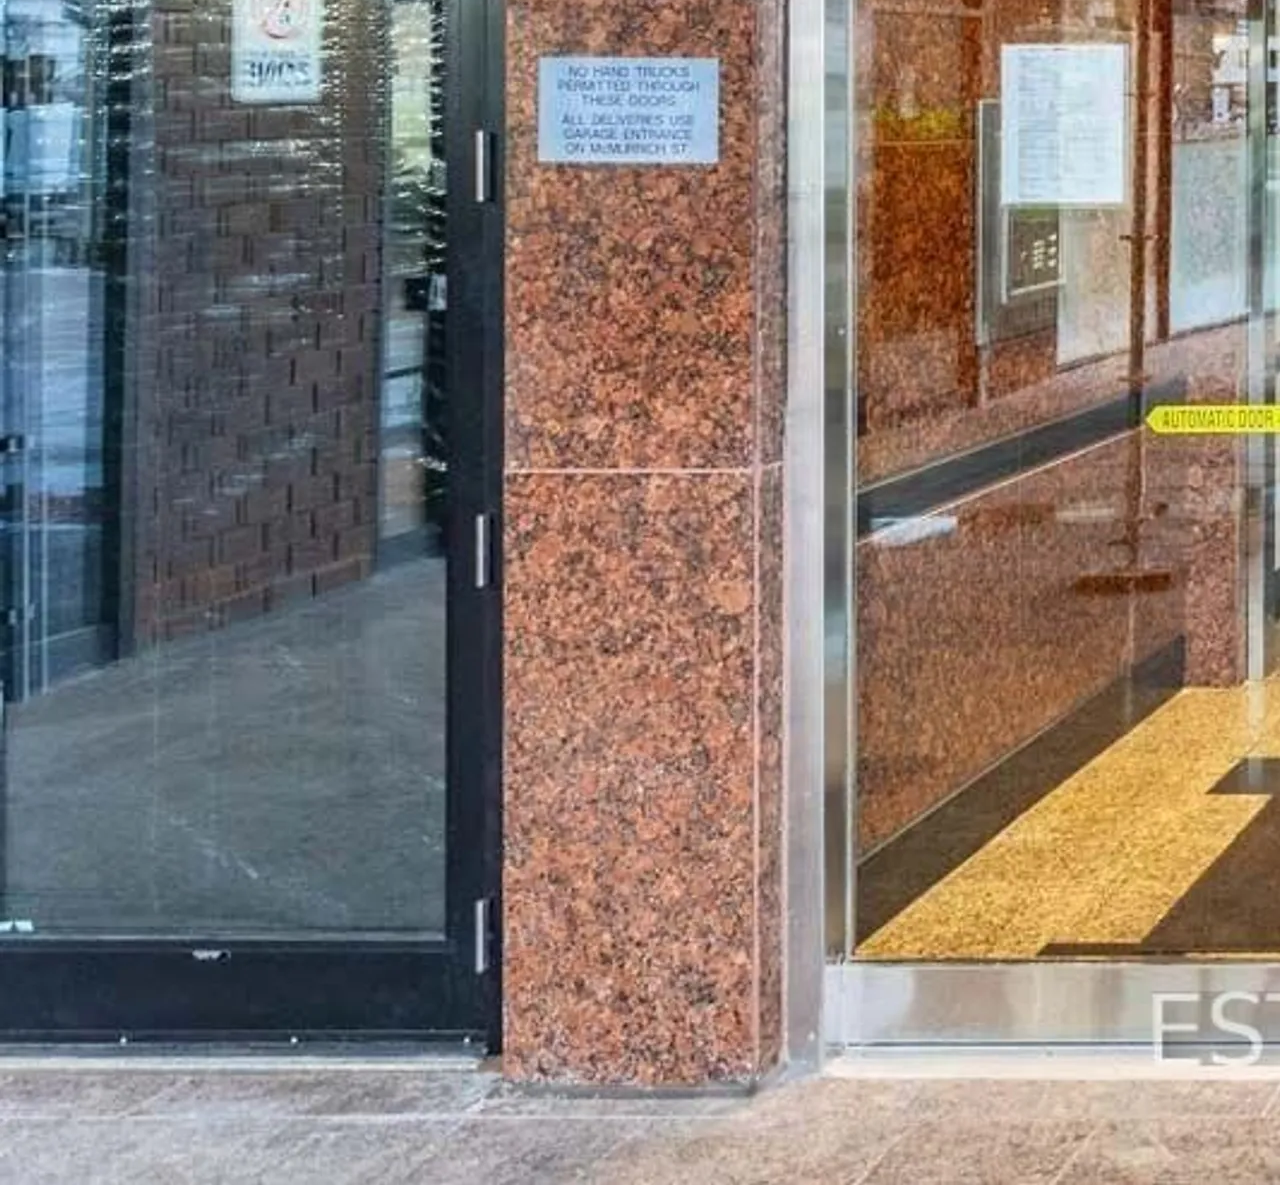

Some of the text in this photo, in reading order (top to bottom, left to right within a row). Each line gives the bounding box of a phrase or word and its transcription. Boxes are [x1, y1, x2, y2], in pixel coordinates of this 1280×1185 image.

[568, 66, 690, 78] NO HAND TRUCKS
[557, 80, 699, 92] PERMITTED THROUGH
[582, 94, 624, 106] THESE
[562, 114, 585, 126] ALL
[669, 114, 694, 126] USE
[563, 129, 692, 140] GARAGE ENTRANCE
[565, 143, 584, 155] ON
[1163, 408, 1235, 428] AUTOMATIC
[1238, 408, 1274, 428] DOOR
